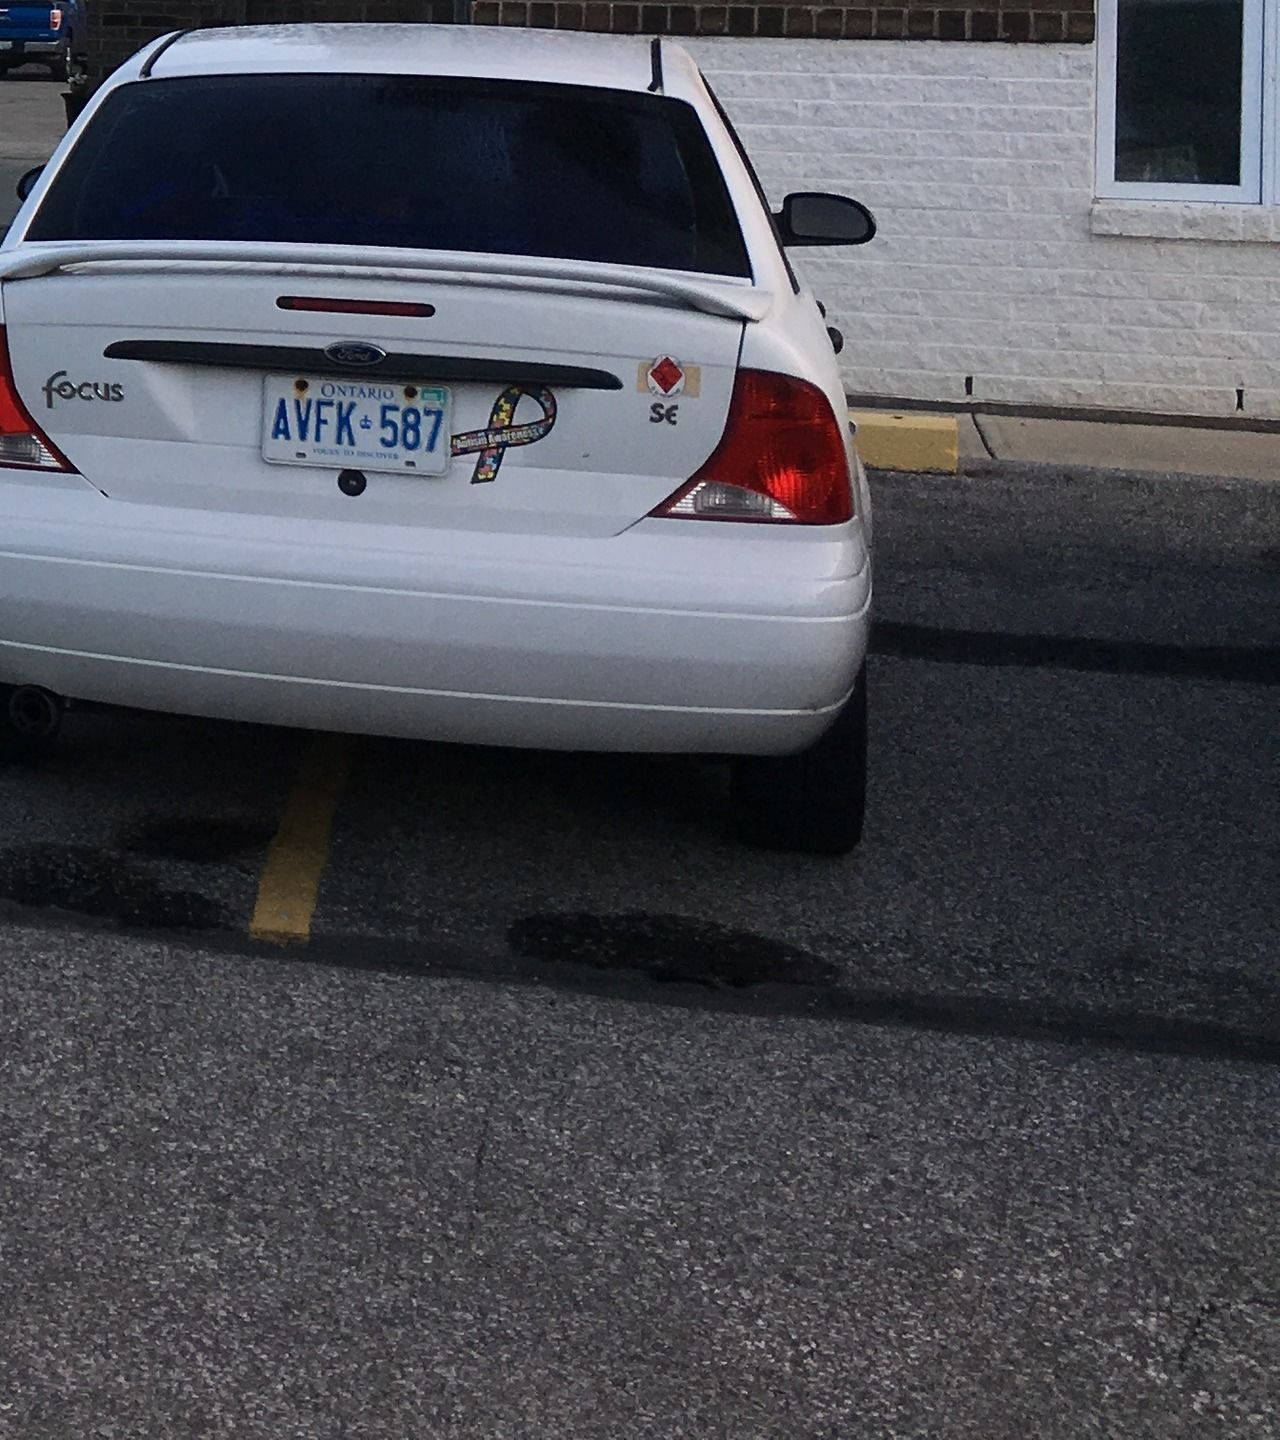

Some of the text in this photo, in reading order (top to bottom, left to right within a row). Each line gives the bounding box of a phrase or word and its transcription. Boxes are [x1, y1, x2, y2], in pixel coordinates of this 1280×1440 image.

[321, 382, 394, 400] ONTARIO
[271, 397, 443, 453] AVFK 587
[649, 402, 679, 426] SE
